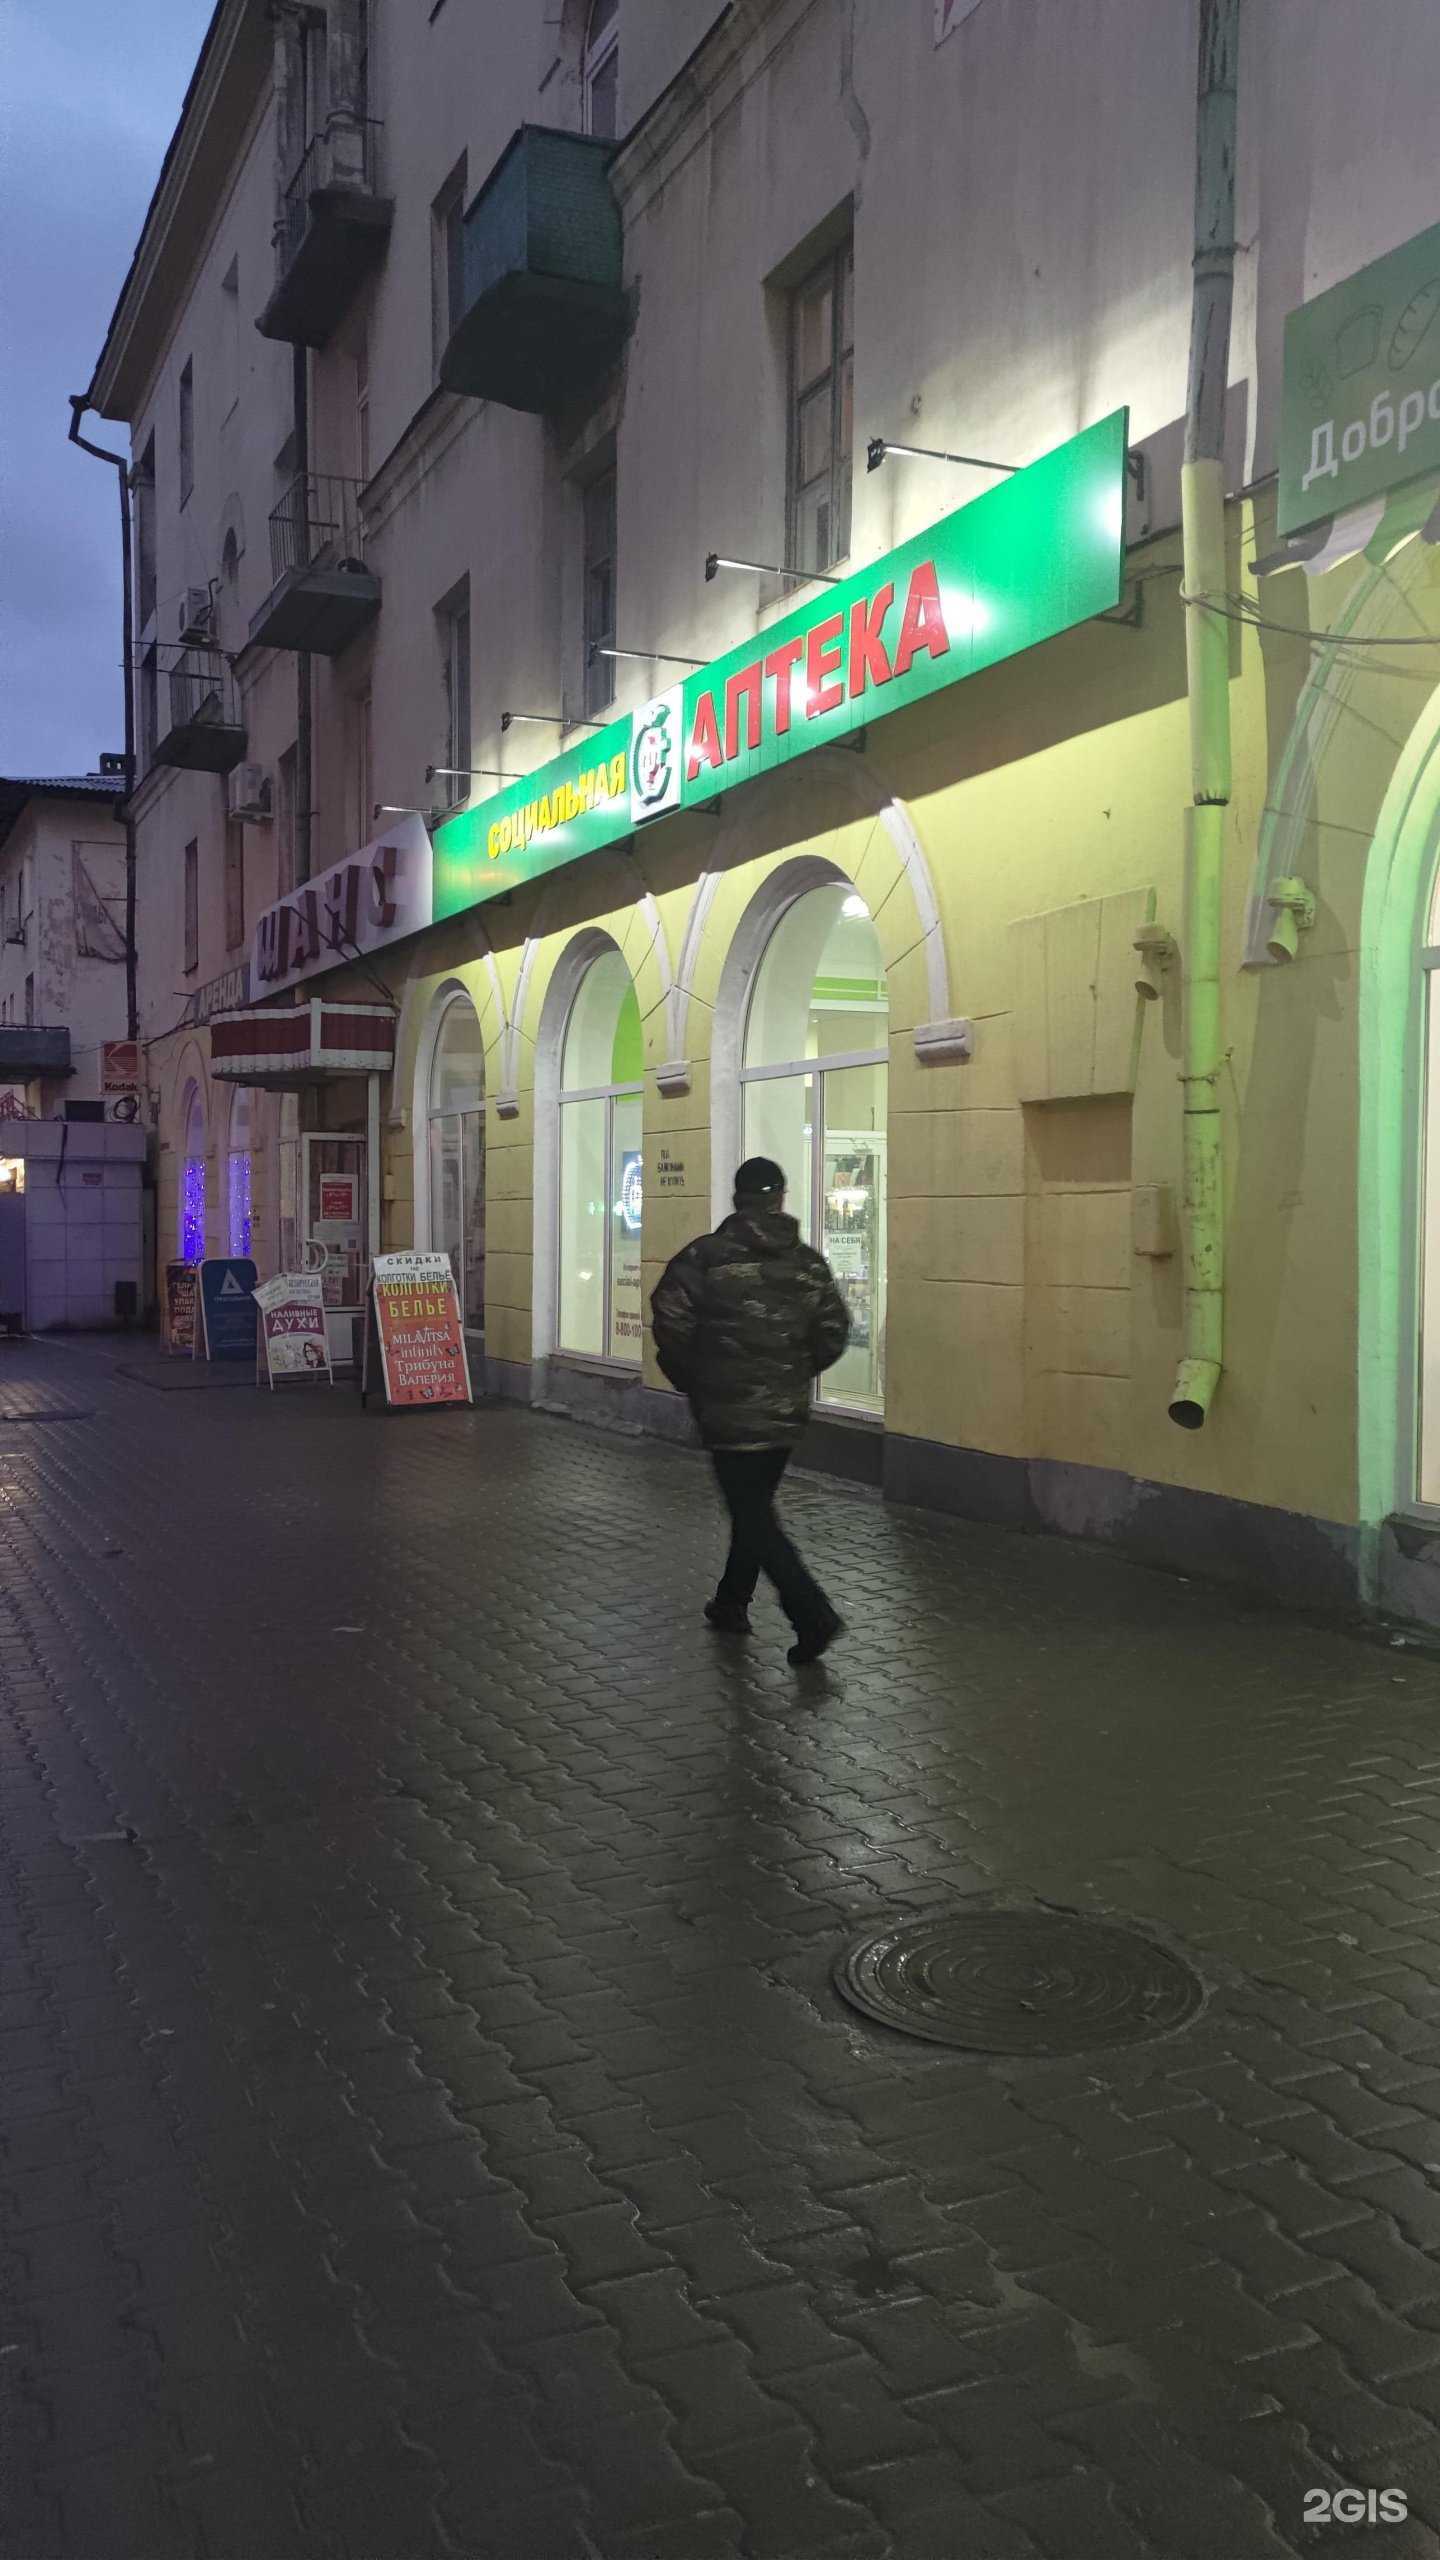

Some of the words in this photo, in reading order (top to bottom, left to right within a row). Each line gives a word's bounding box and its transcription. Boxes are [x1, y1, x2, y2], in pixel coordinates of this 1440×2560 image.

[487, 752, 627, 860] СОЦИАЛЬНАЯ
[686, 560, 951, 781] АПТЕКА
[198, 968, 243, 1019] АРЕНДА
[104, 1082, 138, 1091] Kodak
[387, 1255, 441, 1265] СКИДКИ
[382, 1283, 449, 1297] КОЛГОТКИ
[271, 1309, 318, 1319] НАЛИВНЫЕ
[389, 1298, 447, 1318] БЕЛЬЕ
[272, 1317, 319, 1332] ДУХИ
[395, 1360, 456, 1375] Трибуна
